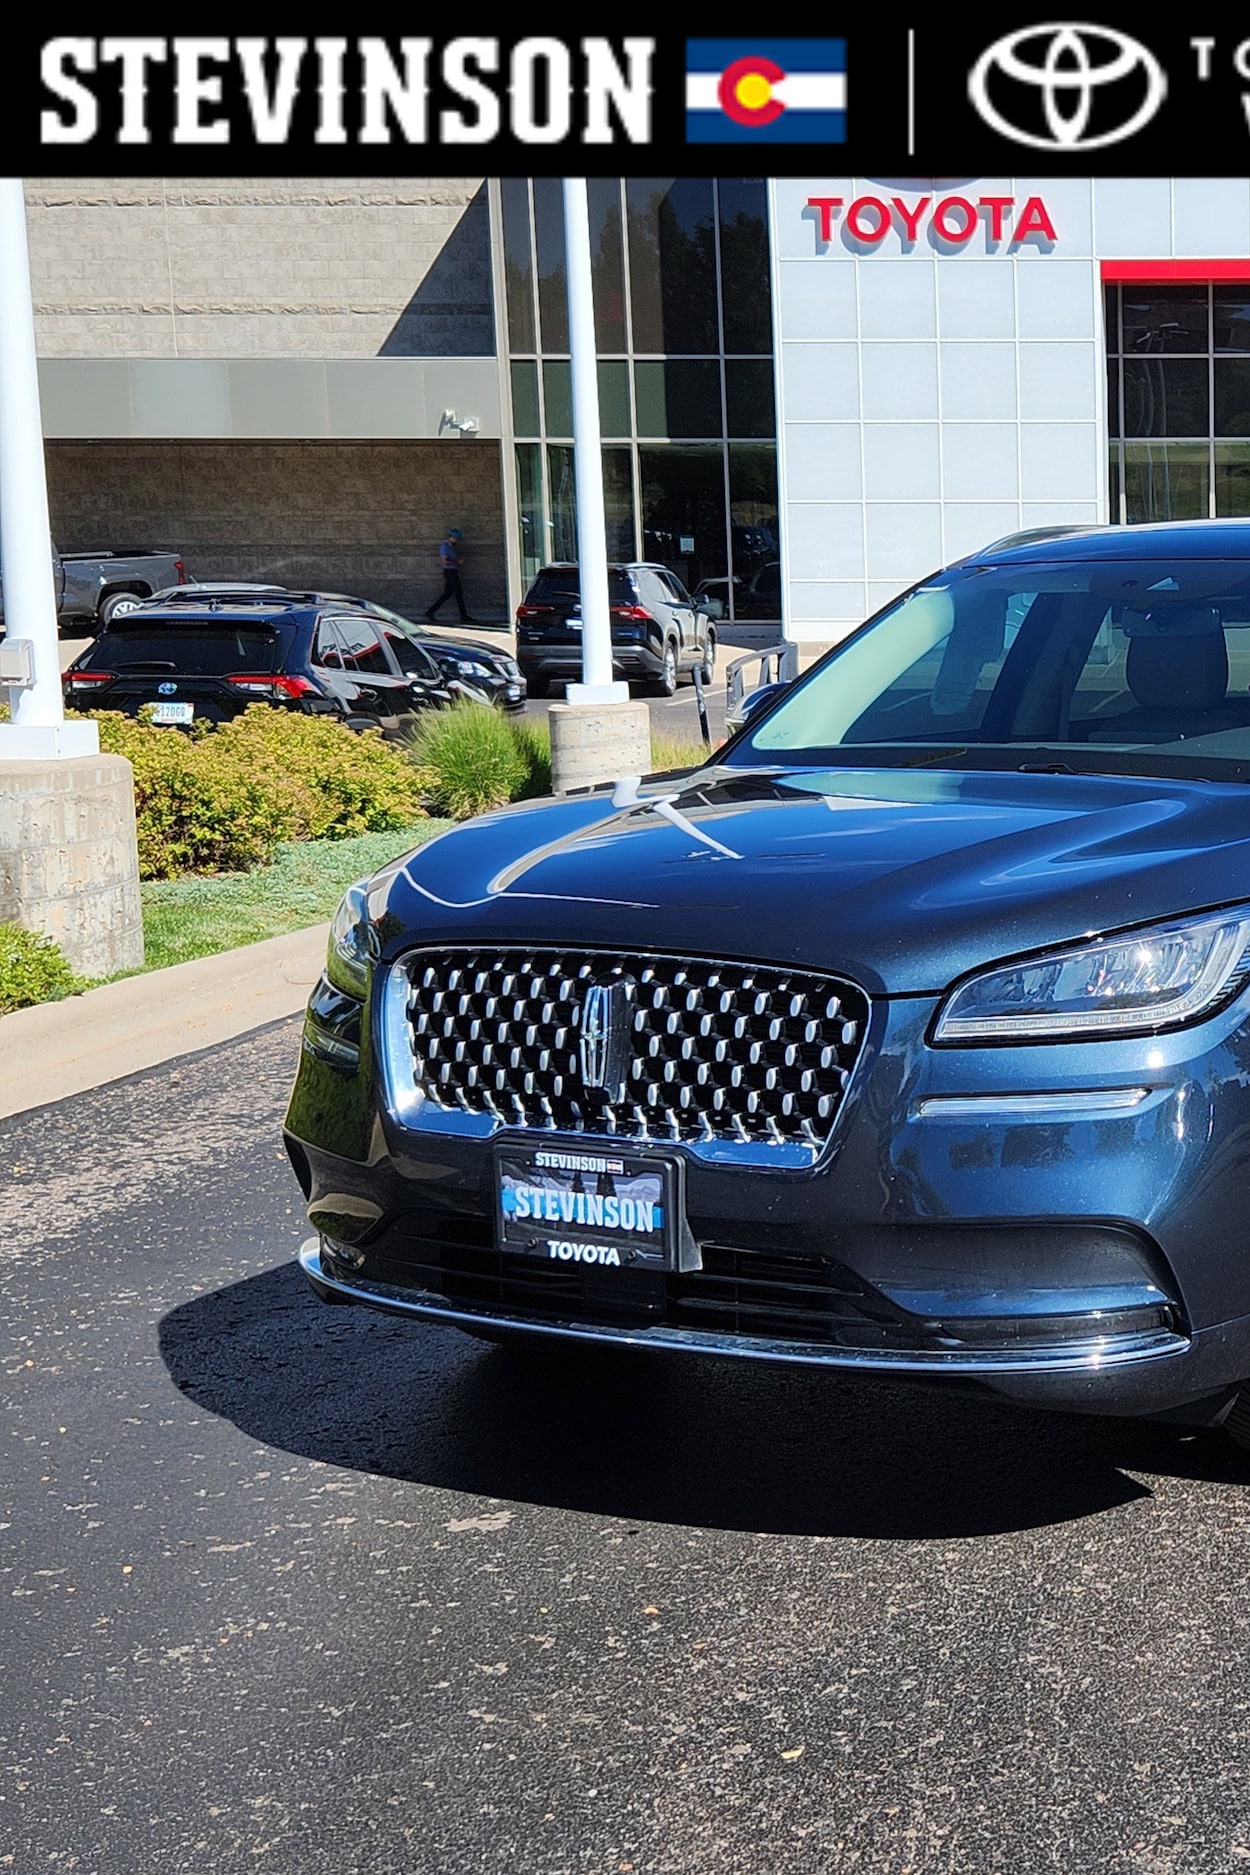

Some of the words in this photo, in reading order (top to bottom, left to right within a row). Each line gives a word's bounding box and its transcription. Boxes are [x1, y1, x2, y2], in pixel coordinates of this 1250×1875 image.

[807, 196, 1058, 243] TOYOTA
[534, 1151, 607, 1173] STEVINSON
[514, 1186, 656, 1233] STEVINSON
[546, 1239, 622, 1267] TOYOTA
